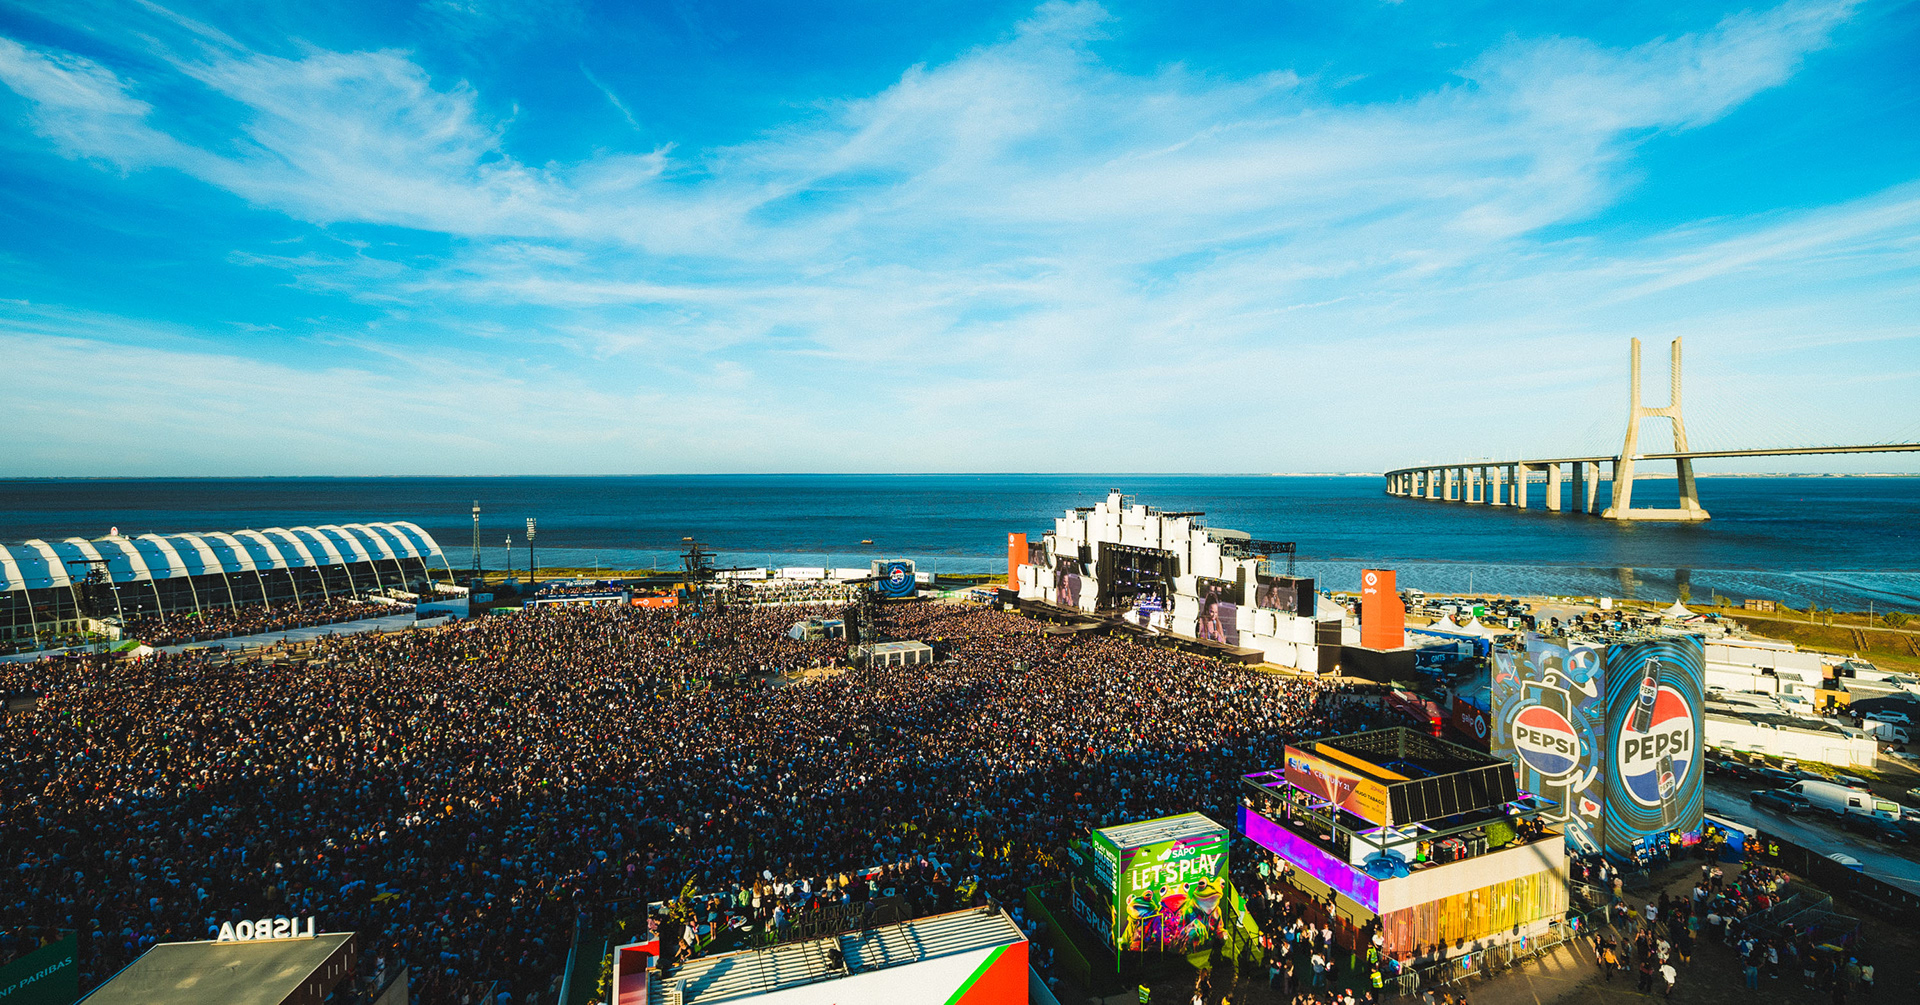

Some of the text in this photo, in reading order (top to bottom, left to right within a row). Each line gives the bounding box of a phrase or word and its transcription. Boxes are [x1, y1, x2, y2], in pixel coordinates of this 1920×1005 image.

[1462, 713, 1474, 727] galp
[1516, 726, 1575, 757] PEPSI
[1624, 728, 1689, 764] PEPSI
[1314, 770, 1343, 788] CENTURY
[1172, 846, 1196, 859] SAPO
[1132, 861, 1178, 891] LET'S
[1179, 852, 1222, 882] PLAY
[1092, 911, 1114, 944] PLAY
[20, 956, 73, 989] PARIBAS
